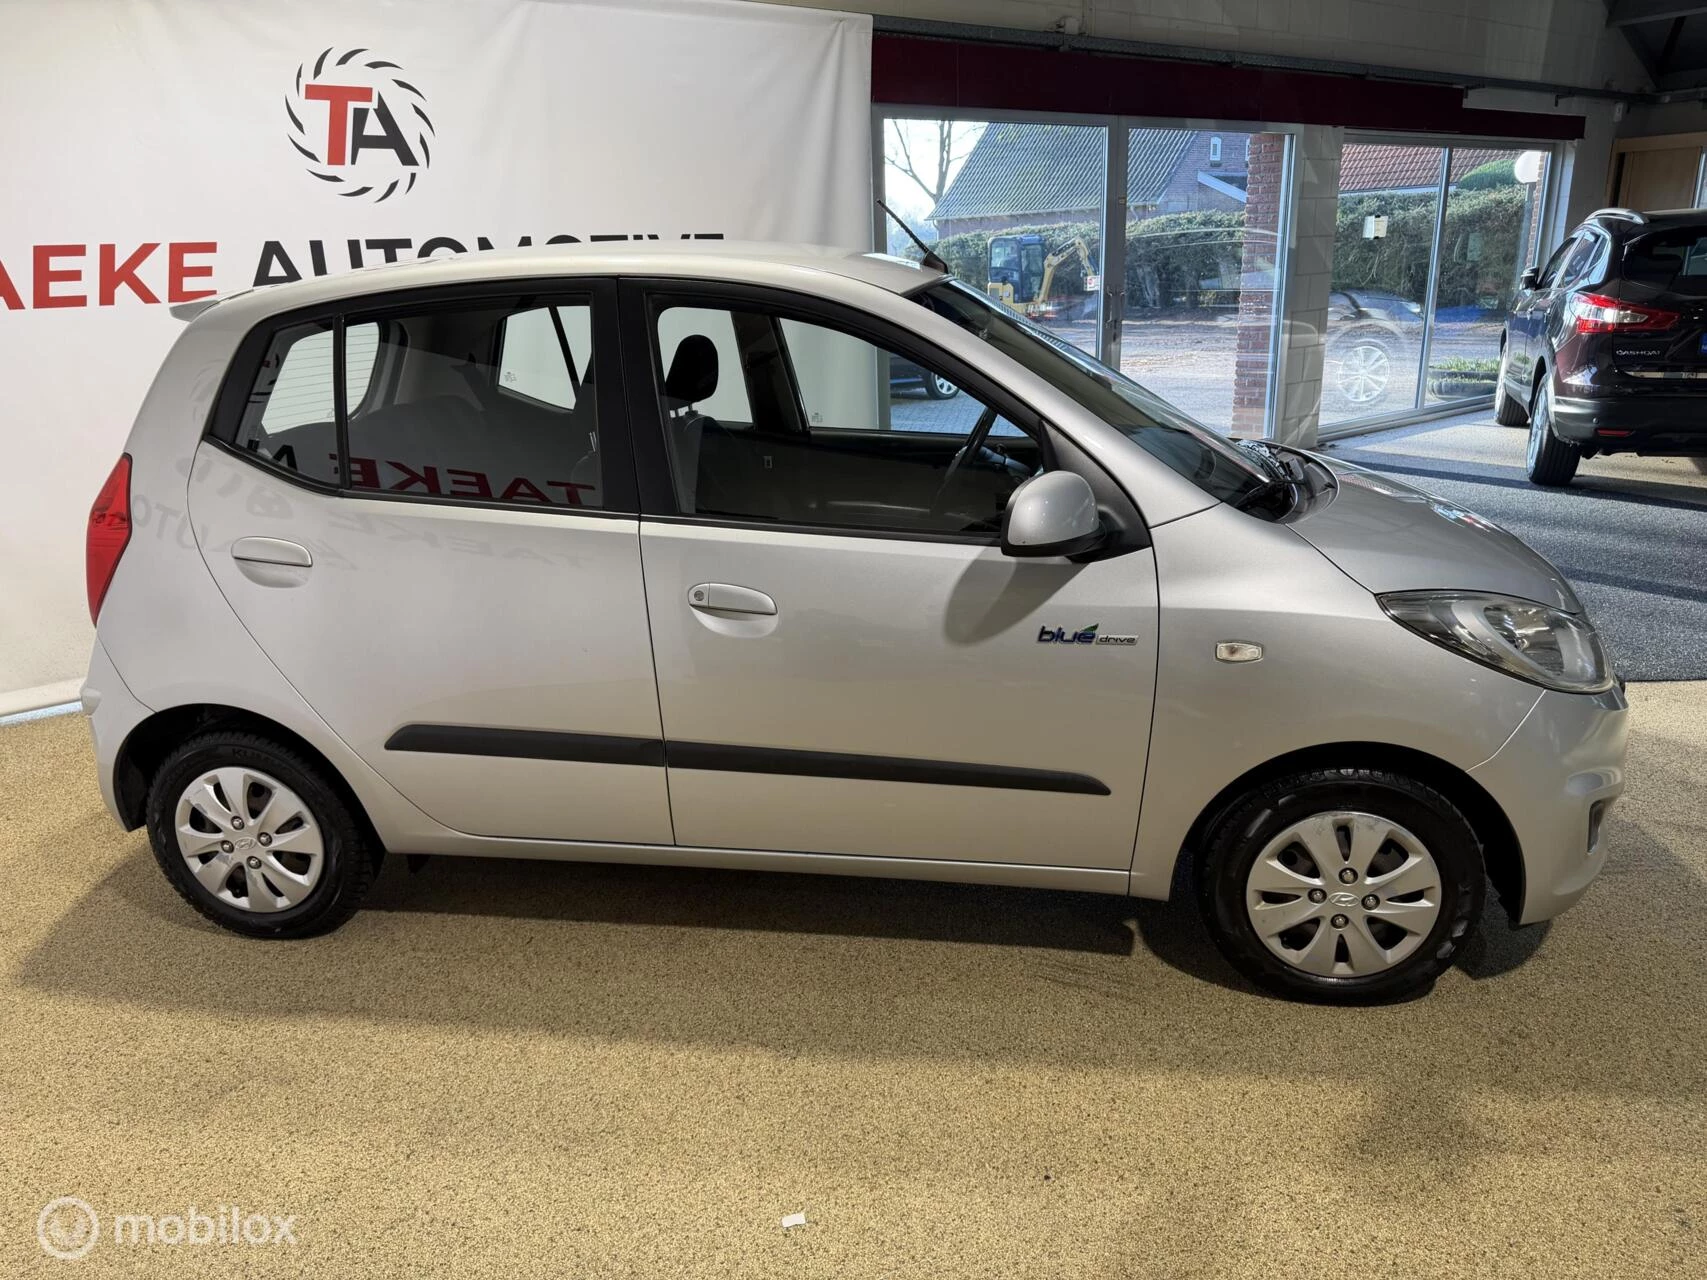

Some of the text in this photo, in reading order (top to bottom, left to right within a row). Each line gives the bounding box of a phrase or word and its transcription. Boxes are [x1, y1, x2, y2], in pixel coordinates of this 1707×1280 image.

[305, 84, 420, 167] TA
[1038, 625, 1137, 644] blue drive
